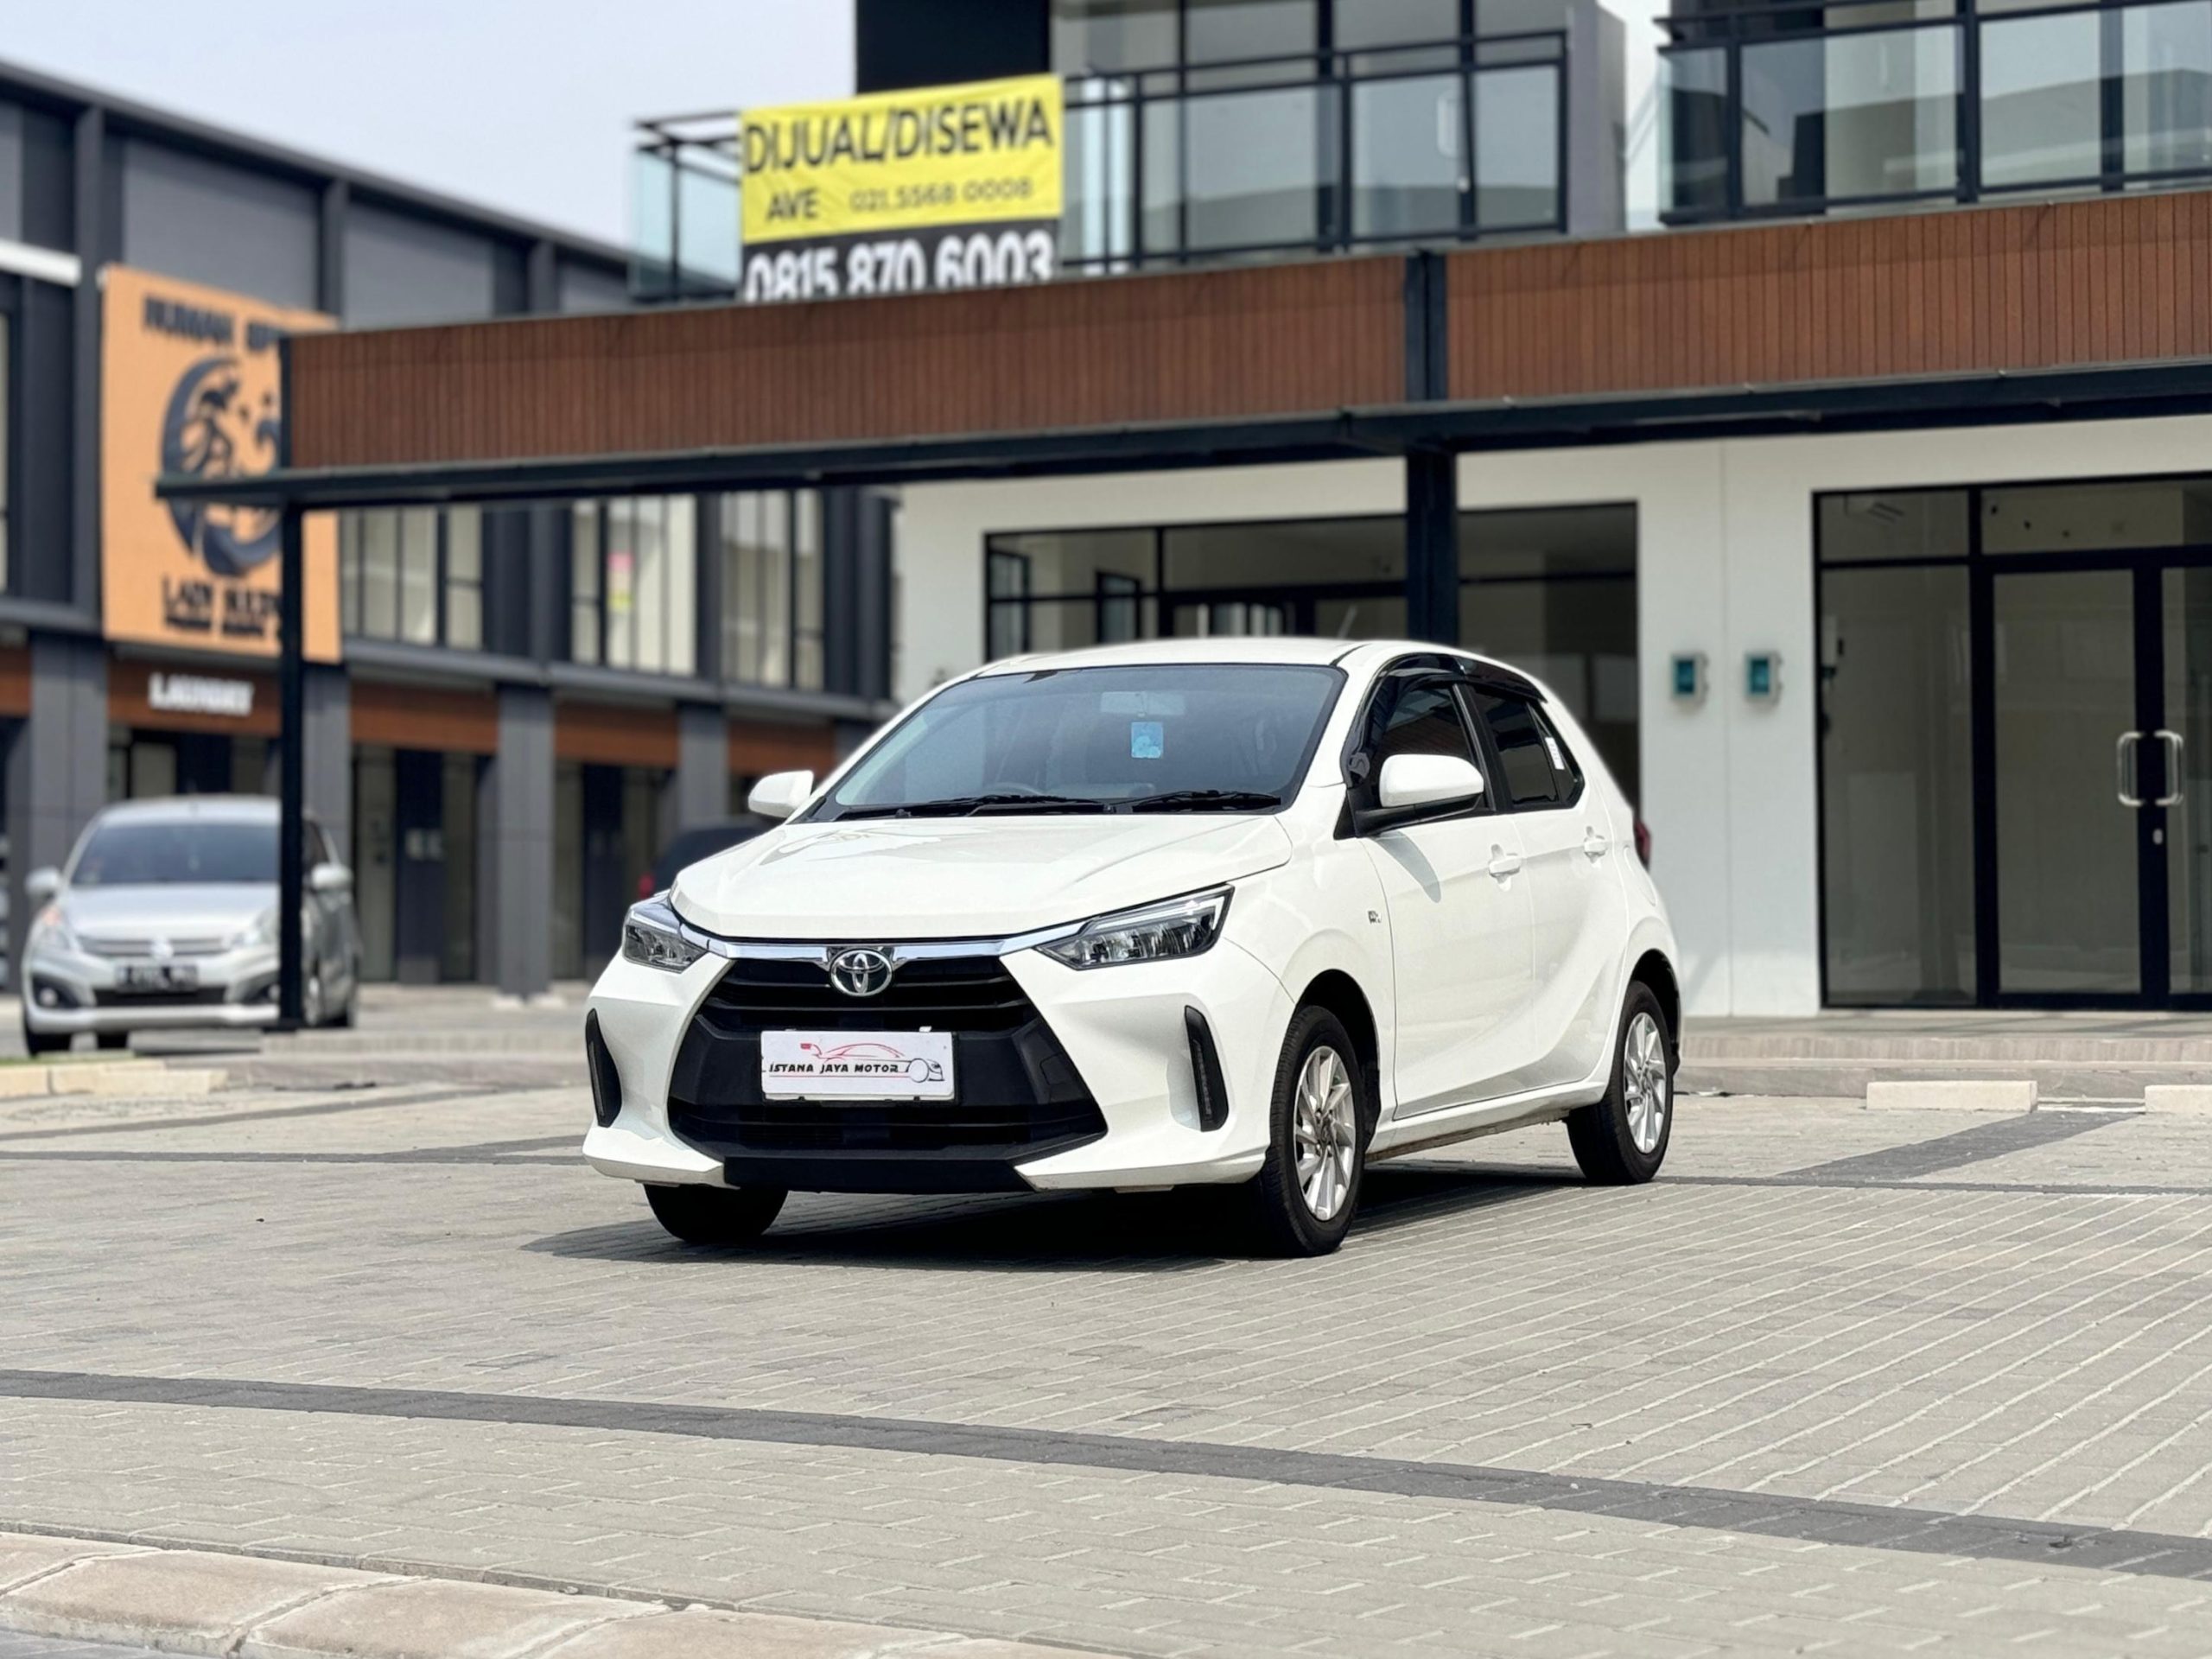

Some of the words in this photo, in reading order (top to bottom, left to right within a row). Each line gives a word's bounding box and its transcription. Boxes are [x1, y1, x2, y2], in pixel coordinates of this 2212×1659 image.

[745, 97, 1054, 174] DIJUAL/DISEWA
[766, 188, 819, 222] AVE
[768, 1063, 814, 1072] ISTANA
[818, 1063, 849, 1074] JAYA
[854, 1063, 899, 1073] MOTOR
